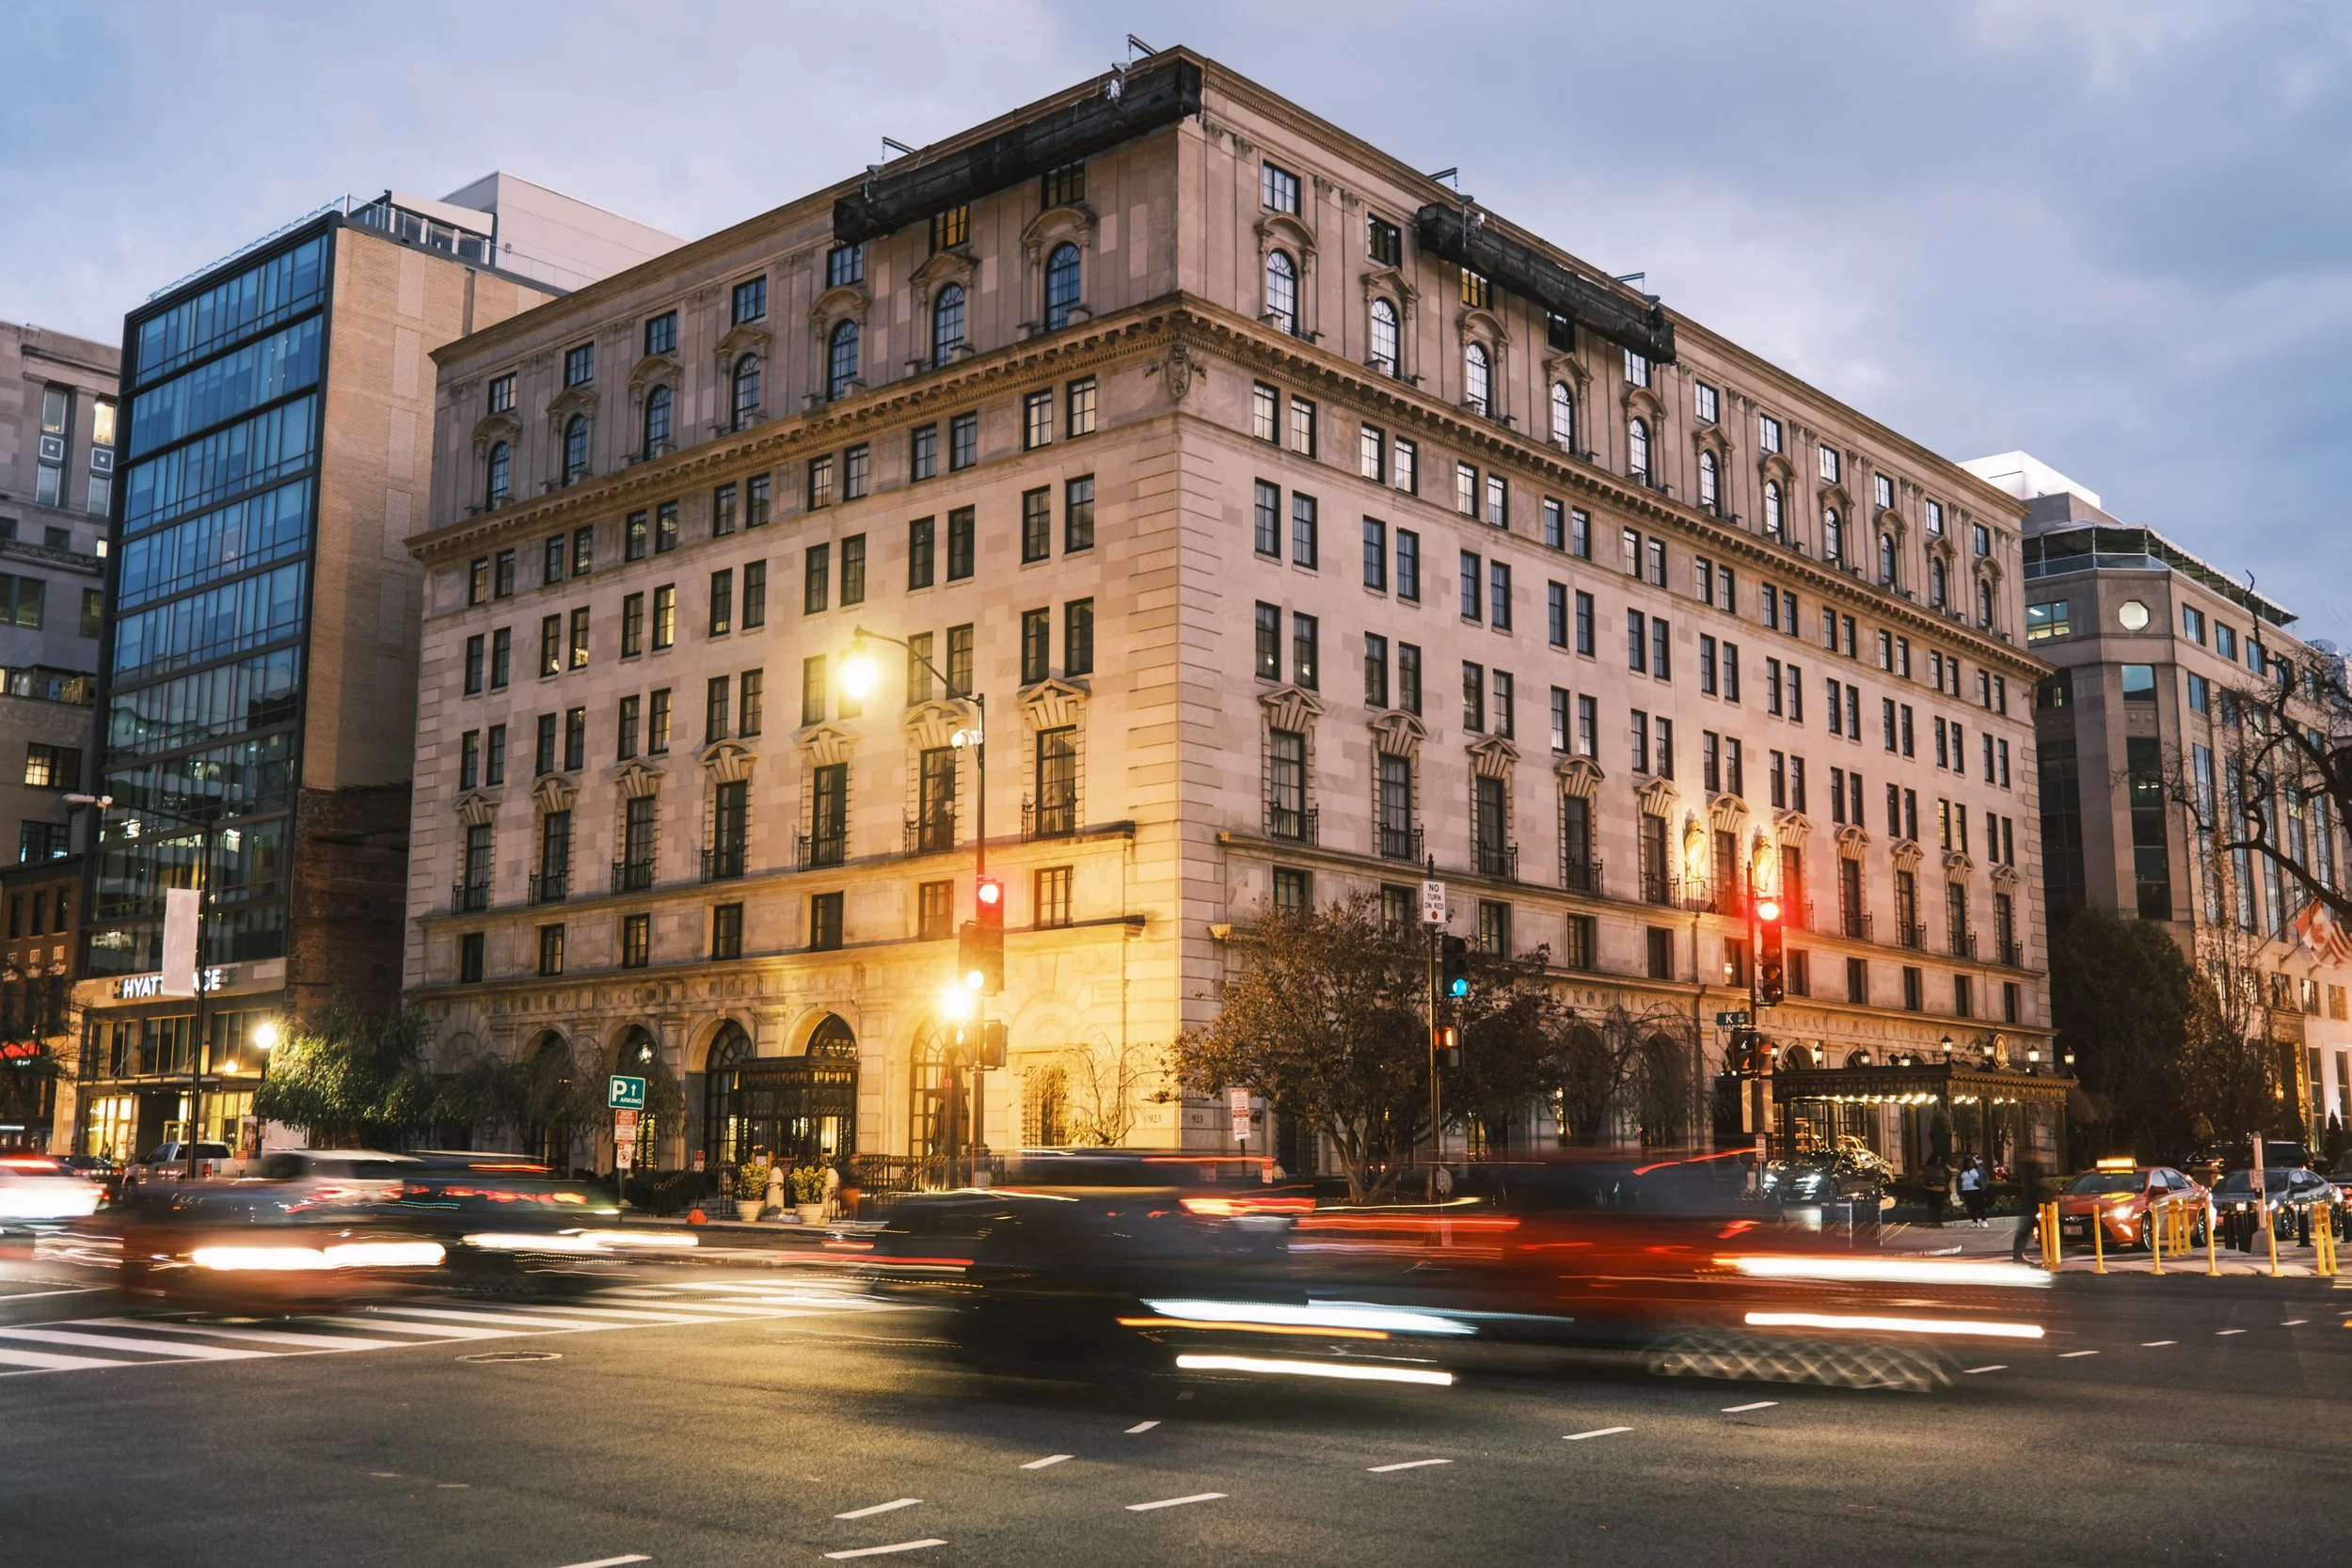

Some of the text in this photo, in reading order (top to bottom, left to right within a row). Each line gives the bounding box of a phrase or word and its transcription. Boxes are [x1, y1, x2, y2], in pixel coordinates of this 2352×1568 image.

[1428, 883, 1439, 893] NO
[1427, 893, 1441, 901] TURN
[1434, 902, 1445, 911] RED
[1725, 1013, 1734, 1024] K
[1148, 1114, 1162, 1124] 923
[1191, 1114, 1204, 1124] 923
